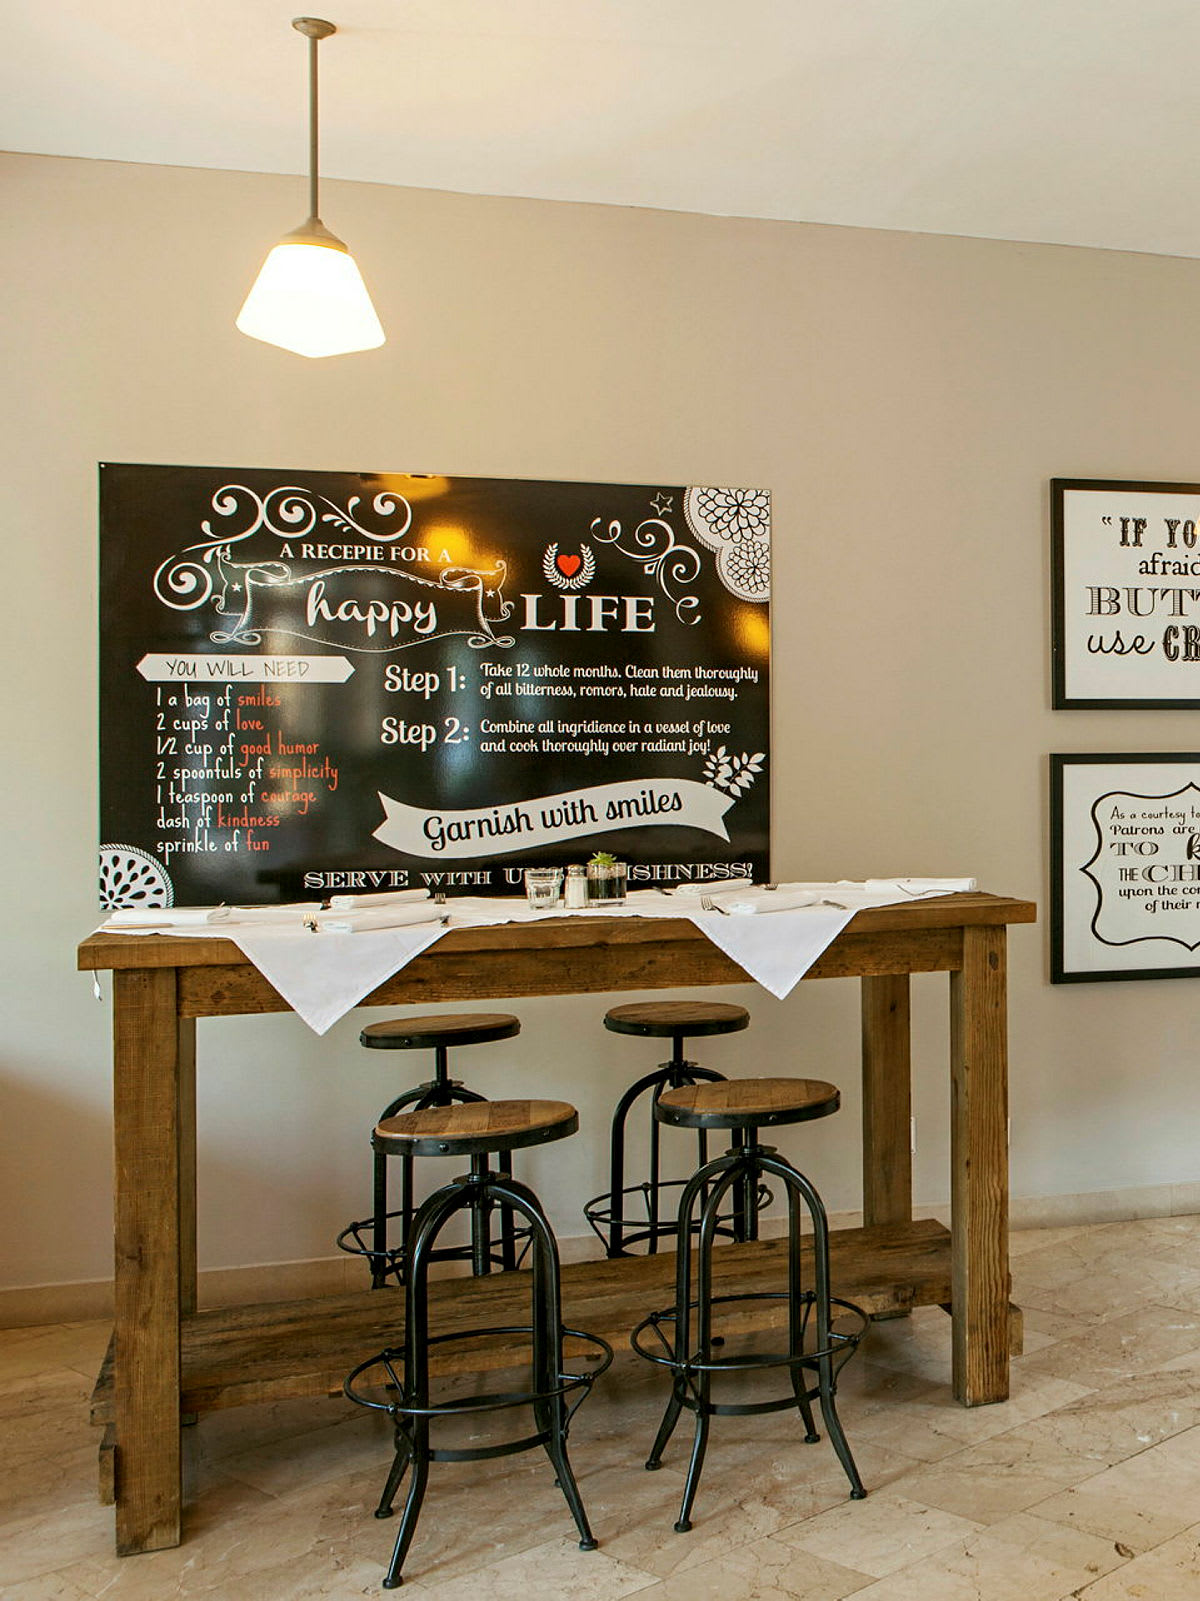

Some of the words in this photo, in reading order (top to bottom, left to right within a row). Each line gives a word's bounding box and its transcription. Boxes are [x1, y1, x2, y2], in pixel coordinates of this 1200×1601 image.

[280, 544, 294, 559] A
[302, 545, 384, 560] RECEPIE
[390, 546, 431, 562] FOR
[438, 549, 453, 563] A
[306, 581, 437, 637] happy
[520, 594, 656, 632] LIFE
[1087, 630, 1155, 656] use
[166, 659, 197, 677] YOU
[207, 660, 253, 677] WILL
[264, 660, 309, 677] NEED
[480, 663, 512, 677] Take
[516, 664, 530, 677] 12
[533, 664, 570, 678] whole
[573, 665, 622, 679] months.
[626, 664, 659, 679] Clean
[662, 665, 692, 679] them
[695, 666, 759, 683] thoroughly
[384, 664, 439, 700] Step
[447, 666, 466, 692] 1:
[480, 682, 495, 699] of
[495, 683, 513, 697] all
[515, 683, 577, 699] bitterness,
[579, 684, 627, 699] romors,
[630, 684, 657, 698] hate
[659, 684, 684, 698] and
[685, 684, 738, 701] jealousy.
[168, 697, 177, 706] a
[185, 683, 211, 718] bag
[217, 685, 232, 707] of
[238, 685, 281, 707] smiles
[156, 713, 166, 731] 2
[173, 717, 209, 743] cups
[215, 709, 231, 731] of
[236, 709, 264, 731] love
[380, 717, 437, 751] Step
[444, 717, 470, 744] 2:
[480, 718, 535, 734] Combine
[538, 720, 555, 733] all
[557, 720, 625, 737] ingridience
[628, 720, 641, 733] in
[644, 724, 653, 734] a
[655, 721, 690, 734] vessel
[692, 720, 706, 738] of
[707, 720, 731, 734] love
[157, 737, 178, 755] 1/2
[185, 743, 212, 767] cup
[220, 733, 236, 755] of
[240, 736, 272, 767] good
[279, 731, 319, 755] humor
[480, 739, 506, 753] and
[509, 739, 539, 753] cook
[542, 740, 609, 757] thoroughly
[612, 742, 638, 753] over
[641, 740, 686, 753] radiant
[687, 740, 711, 756] joy!
[156, 762, 166, 780] 2
[173, 758, 242, 792] spoonfuls
[249, 757, 264, 780] of
[269, 757, 339, 791] simplicity
[169, 782, 234, 817] teaspoon
[240, 781, 256, 803] of
[261, 791, 317, 815] courage
[157, 805, 190, 829] dash
[196, 806, 211, 829] of
[217, 802, 280, 828] kindness
[423, 806, 532, 851] Garnish
[541, 799, 599, 830] with
[606, 789, 683, 821] smiles
[1110, 805, 1125, 819] As
[1141, 806, 1186, 825] courtesy
[1191, 806, 1200, 819] to
[1109, 823, 1165, 836] Patrons
[1173, 825, 1195, 835] are
[157, 827, 217, 865] sprinkle
[225, 830, 240, 853] of
[246, 831, 270, 852] fun
[1110, 841, 1159, 856] TO
[304, 869, 409, 889] SERVE
[420, 871, 492, 887] WITH
[1119, 867, 1138, 882] THE
[1119, 886, 1153, 899] upon
[1157, 885, 1178, 896] the
[1144, 899, 1157, 914] of
[1161, 898, 1192, 910] their
